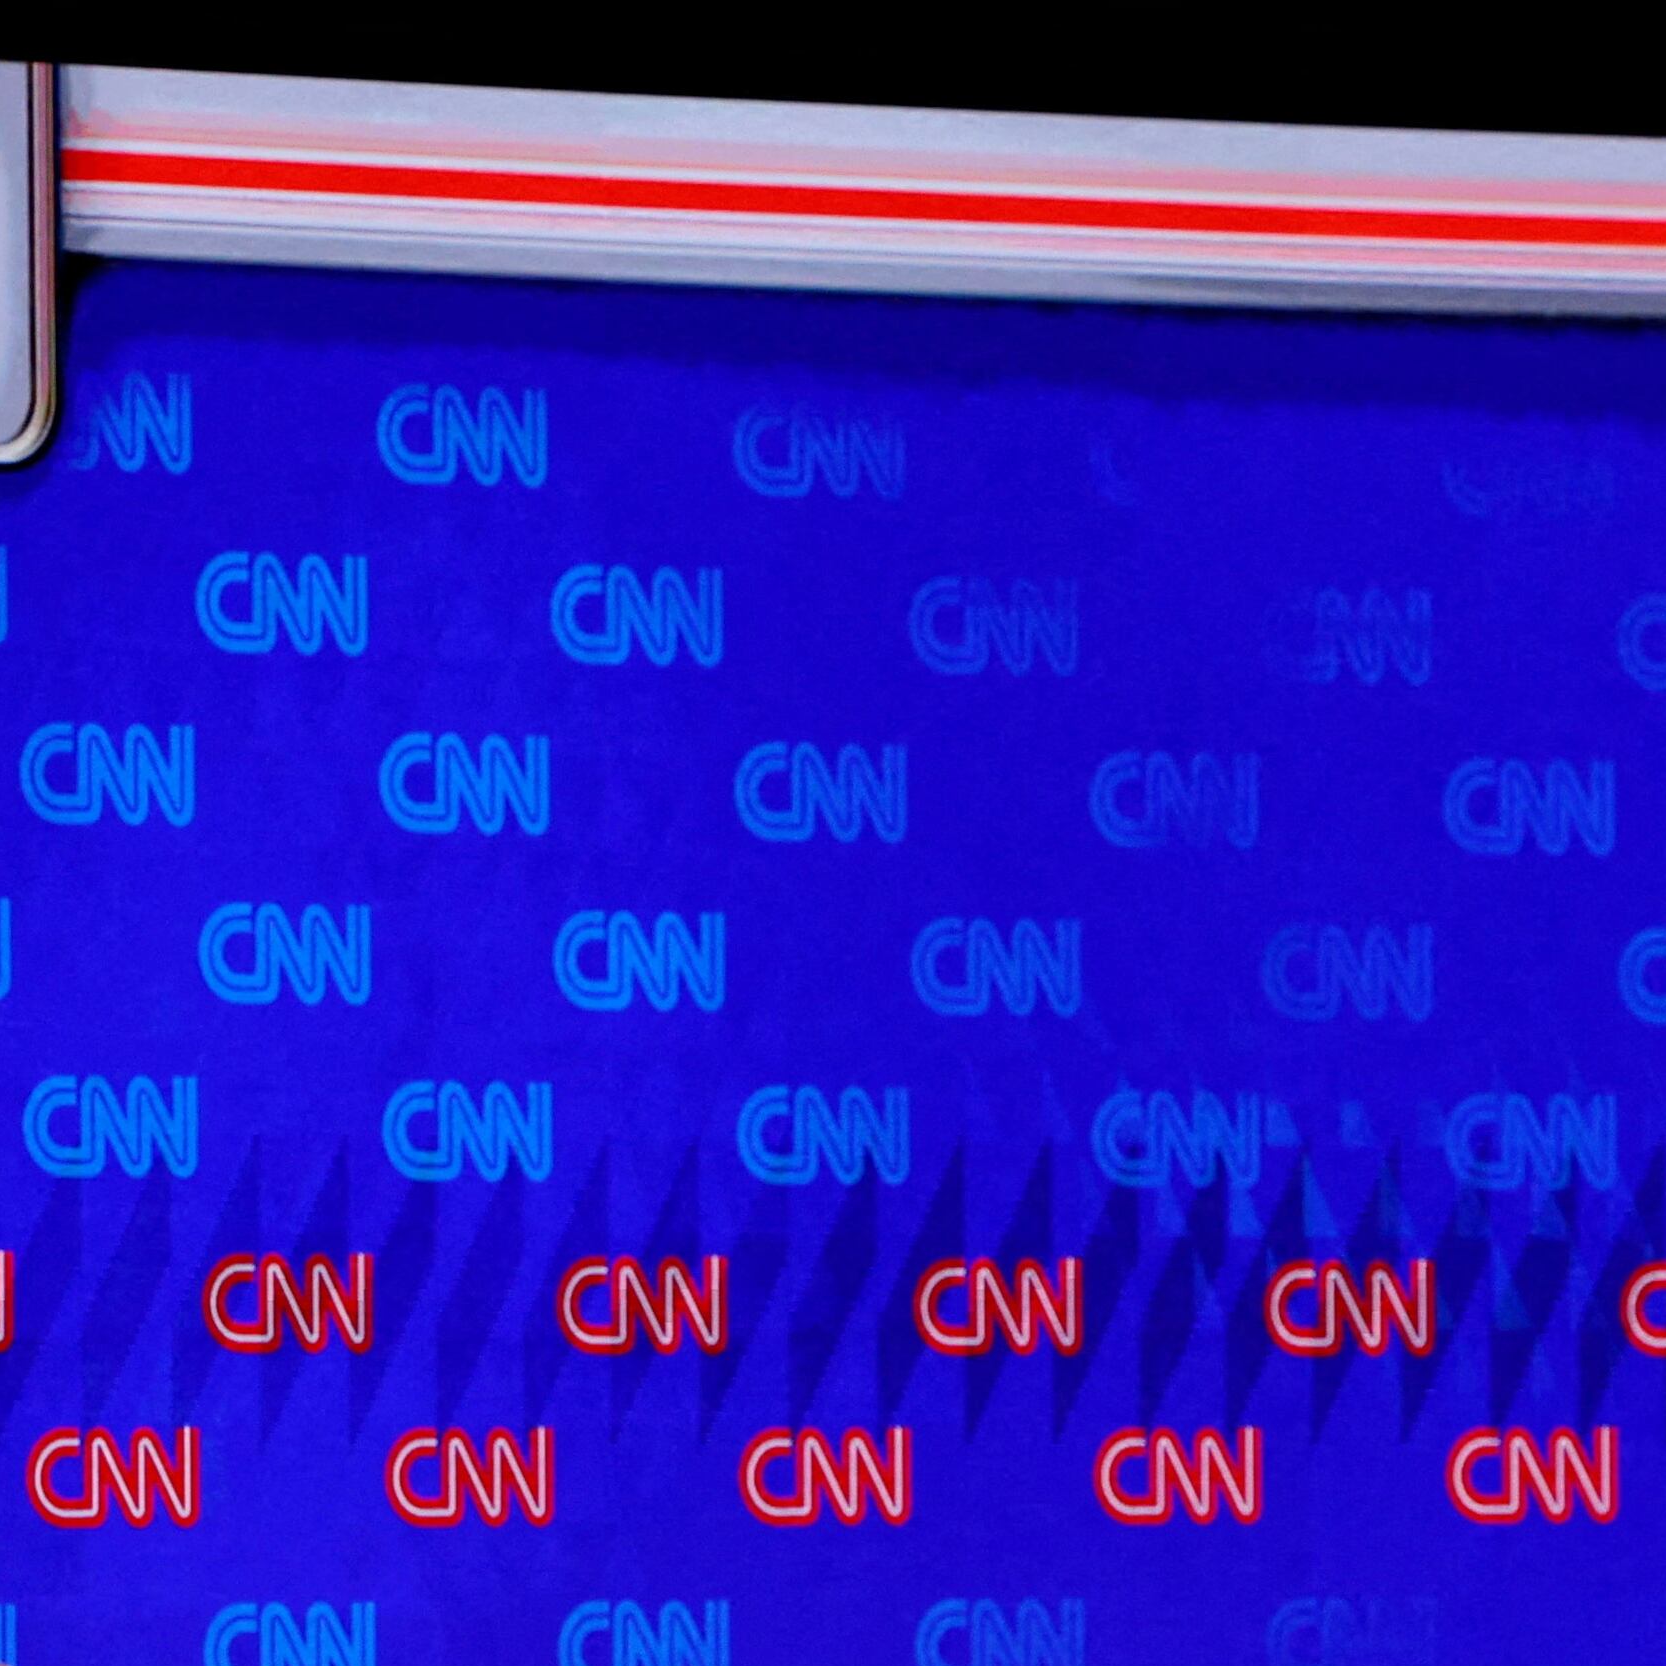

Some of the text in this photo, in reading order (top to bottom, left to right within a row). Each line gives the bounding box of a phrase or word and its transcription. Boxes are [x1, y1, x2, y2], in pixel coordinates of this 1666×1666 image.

[71, 372, 195, 476] NN
[377, 382, 549, 487] CNN
[733, 405, 906, 503] CNN
[194, 550, 369, 656] CNN
[551, 562, 724, 668] CNN
[908, 574, 1080, 677] CNN
[20, 721, 196, 827] CNN
[379, 731, 551, 836] CNN
[734, 741, 909, 844] CNN
[1089, 749, 1260, 851] CNN
[1442, 755, 1617, 857] CNN
[197, 900, 373, 1006] CNN
[552, 908, 726, 1014] CNN
[910, 915, 1083, 1019] CNN
[1261, 922, 1434, 1024] CNN
[23, 1073, 200, 1181] CNN
[381, 1078, 554, 1183] CNN
[737, 1084, 912, 1188] CNN
[1091, 1089, 1263, 1191] CNN
[1442, 1091, 1619, 1193] CNN
[202, 1251, 374, 1354] CNN
[557, 1255, 726, 1355] CNN
[912, 1256, 1083, 1358] CNN
[1264, 1258, 1435, 1358] CNN
[27, 1425, 201, 1528] CNN
[384, 1426, 551, 1528] CNN
[739, 1425, 911, 1526] CNN
[1095, 1425, 1261, 1525] CNN
[1447, 1425, 1619, 1525] CNN
